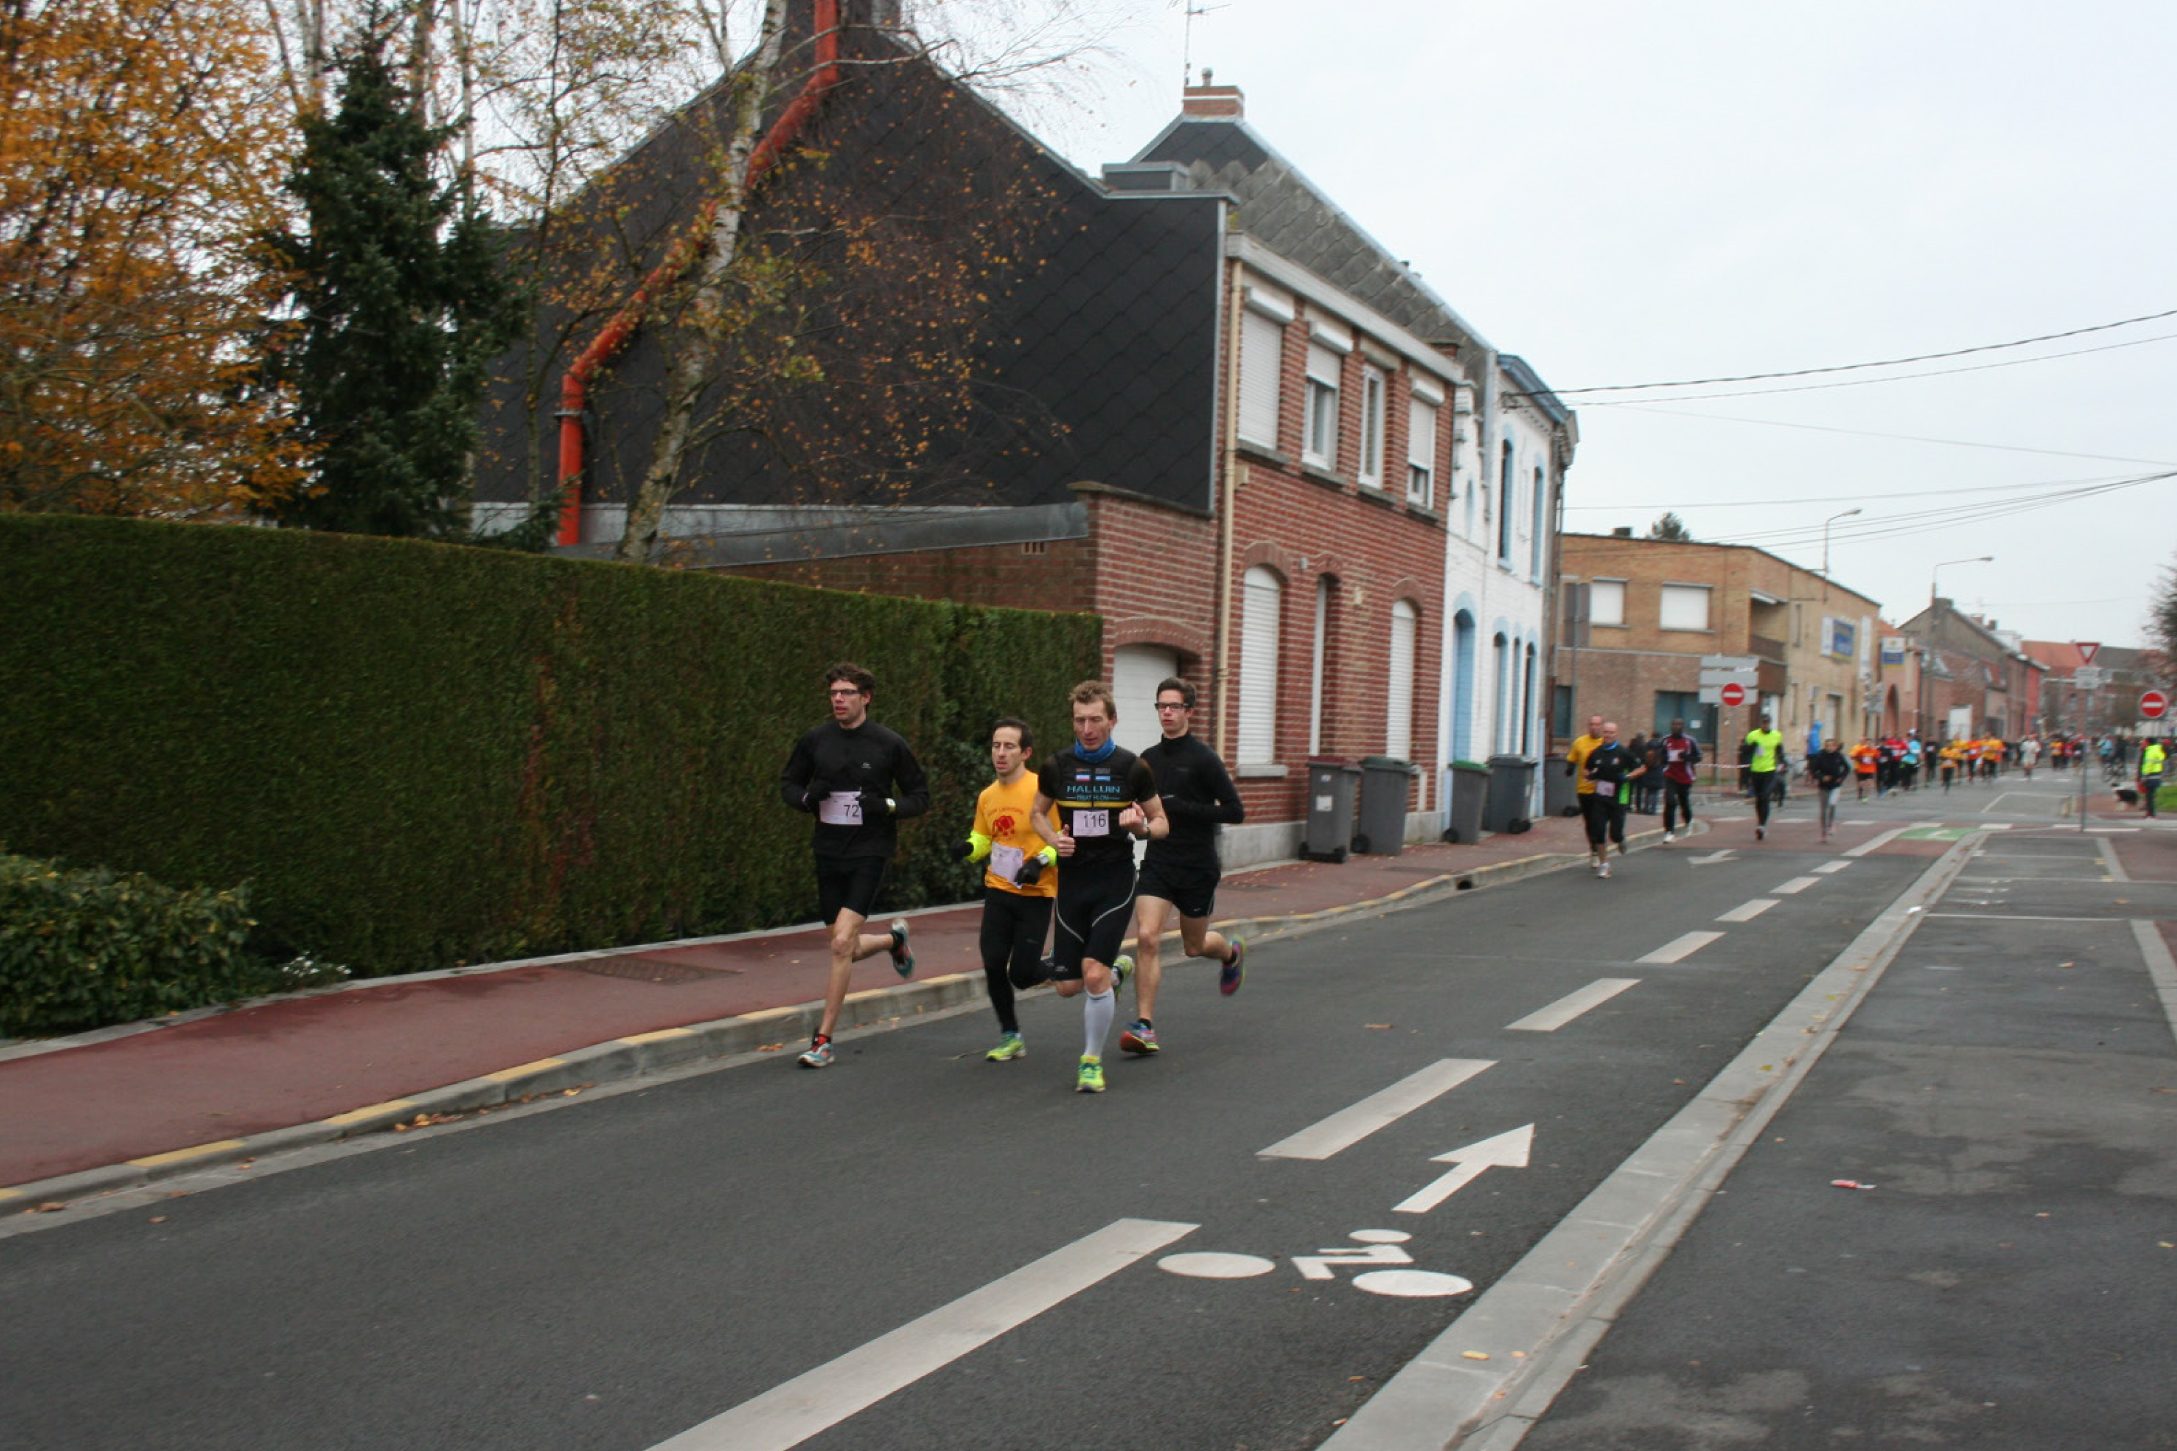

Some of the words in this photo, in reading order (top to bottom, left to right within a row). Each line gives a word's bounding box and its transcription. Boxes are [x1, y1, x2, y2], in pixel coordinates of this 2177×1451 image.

[1066, 785, 1120, 793] HALLUIN
[843, 804, 859, 817] 72
[1084, 813, 1106, 828] 116
